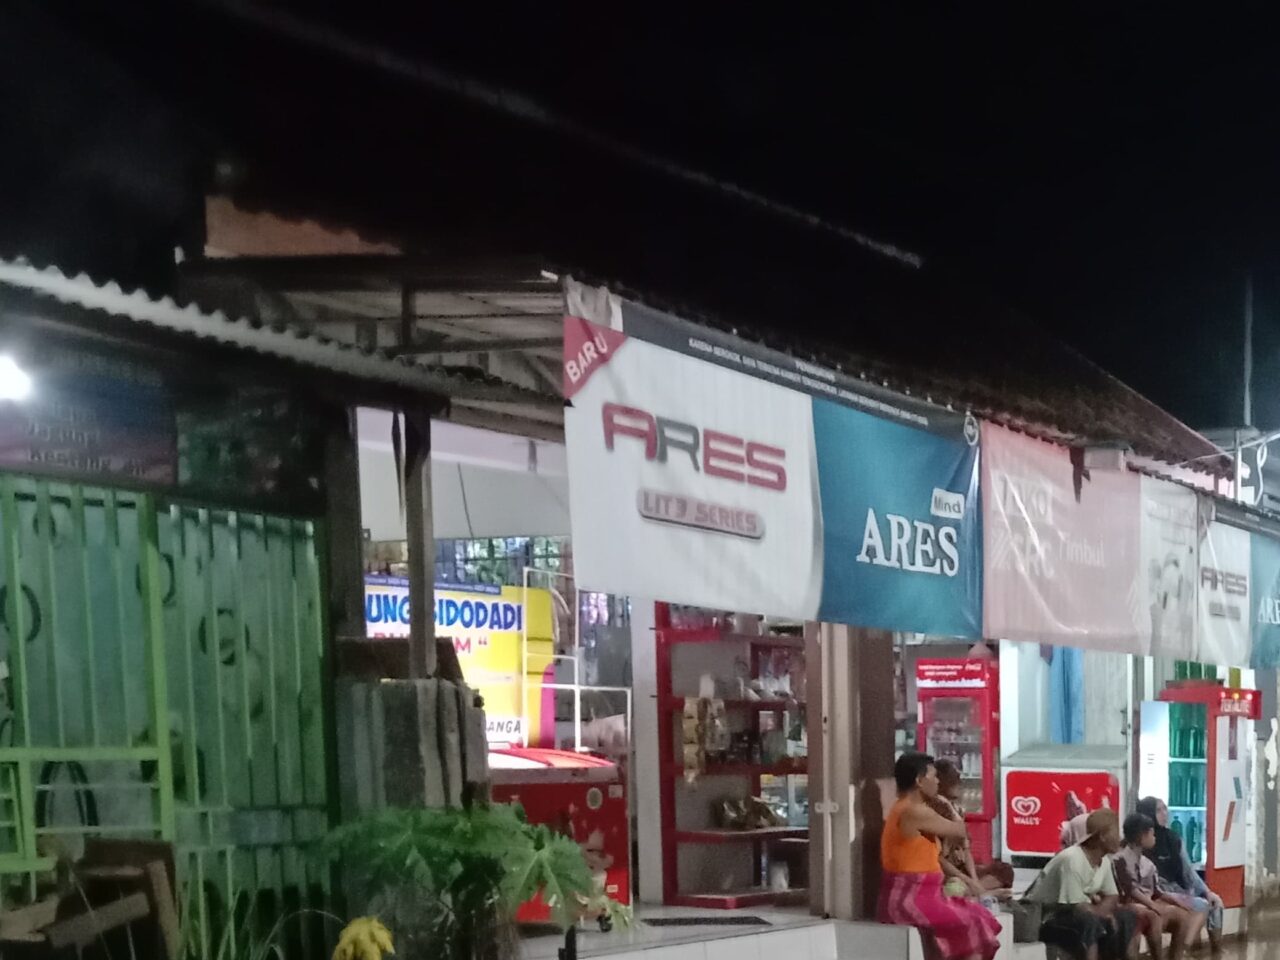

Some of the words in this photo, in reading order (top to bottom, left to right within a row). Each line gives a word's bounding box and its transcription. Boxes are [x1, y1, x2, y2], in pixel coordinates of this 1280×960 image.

[565, 334, 609, 384] BARU
[602, 402, 787, 492] ARES
[695, 501, 757, 533] SERIES
[856, 508, 960, 577] ARES
[433, 598, 523, 631] IDODADI
